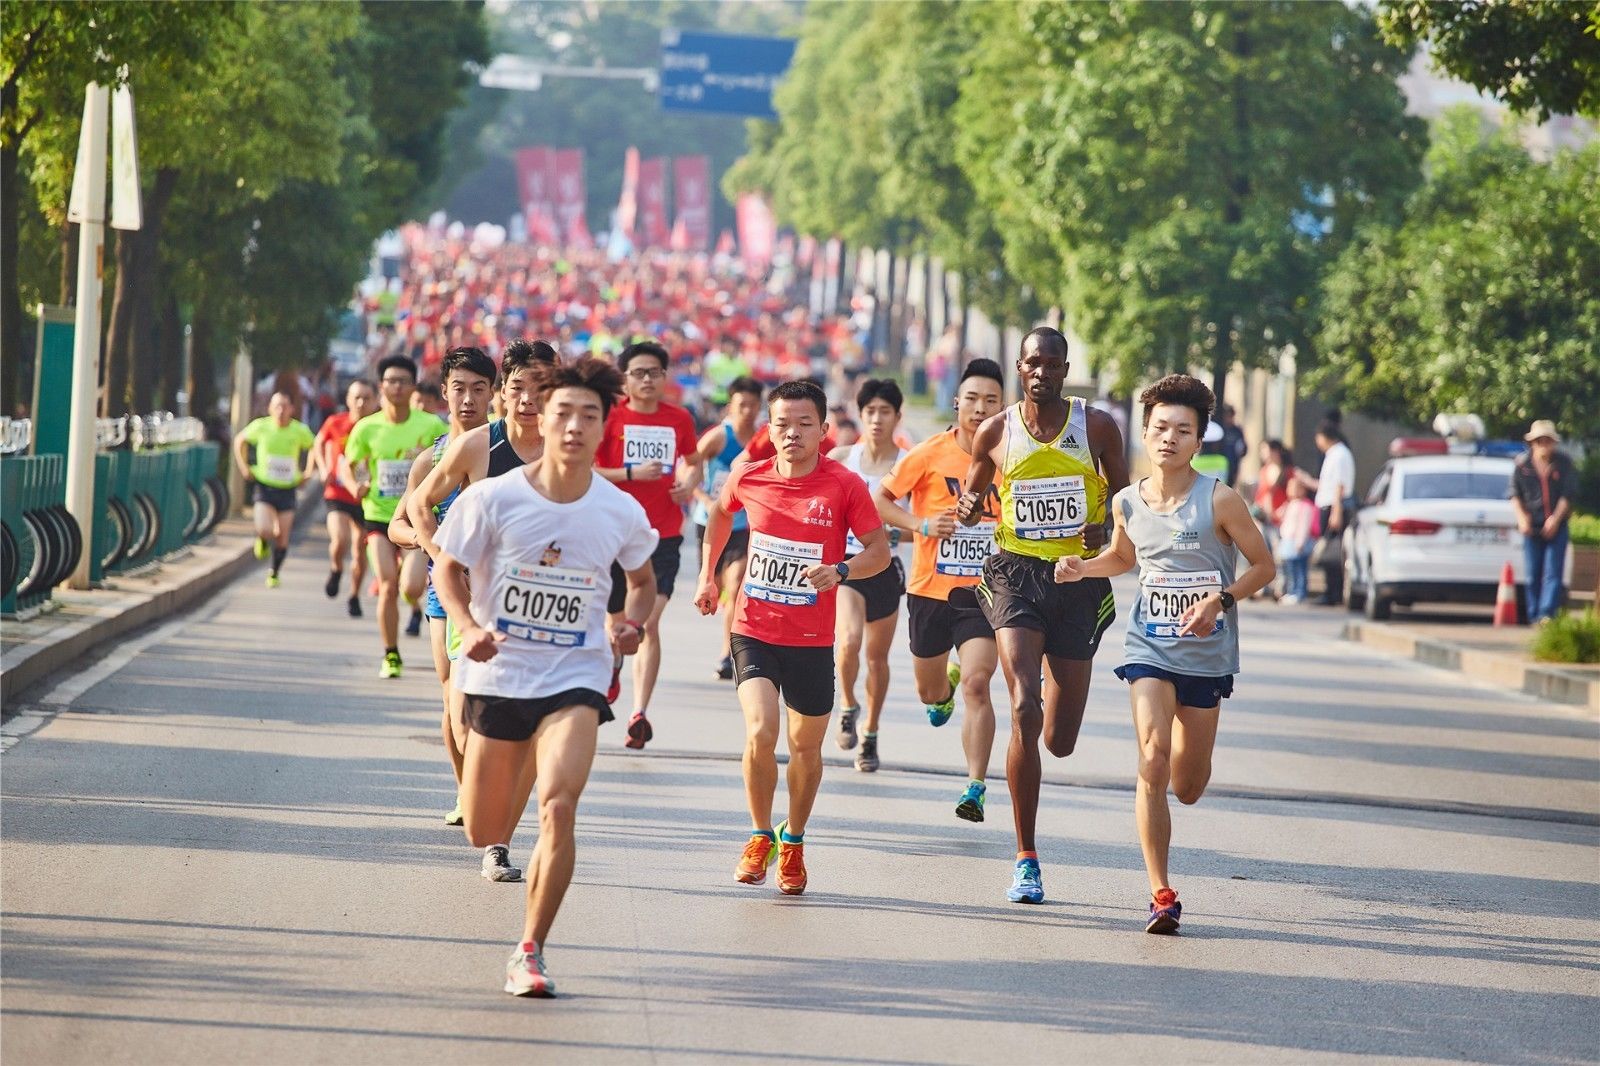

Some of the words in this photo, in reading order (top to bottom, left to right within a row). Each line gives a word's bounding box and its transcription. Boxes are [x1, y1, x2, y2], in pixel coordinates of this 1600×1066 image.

[627, 440, 668, 459] C10361
[1015, 496, 1078, 523] C10576
[940, 538, 992, 560] C10554
[749, 553, 808, 588] C10472
[504, 586, 581, 624] C10796
